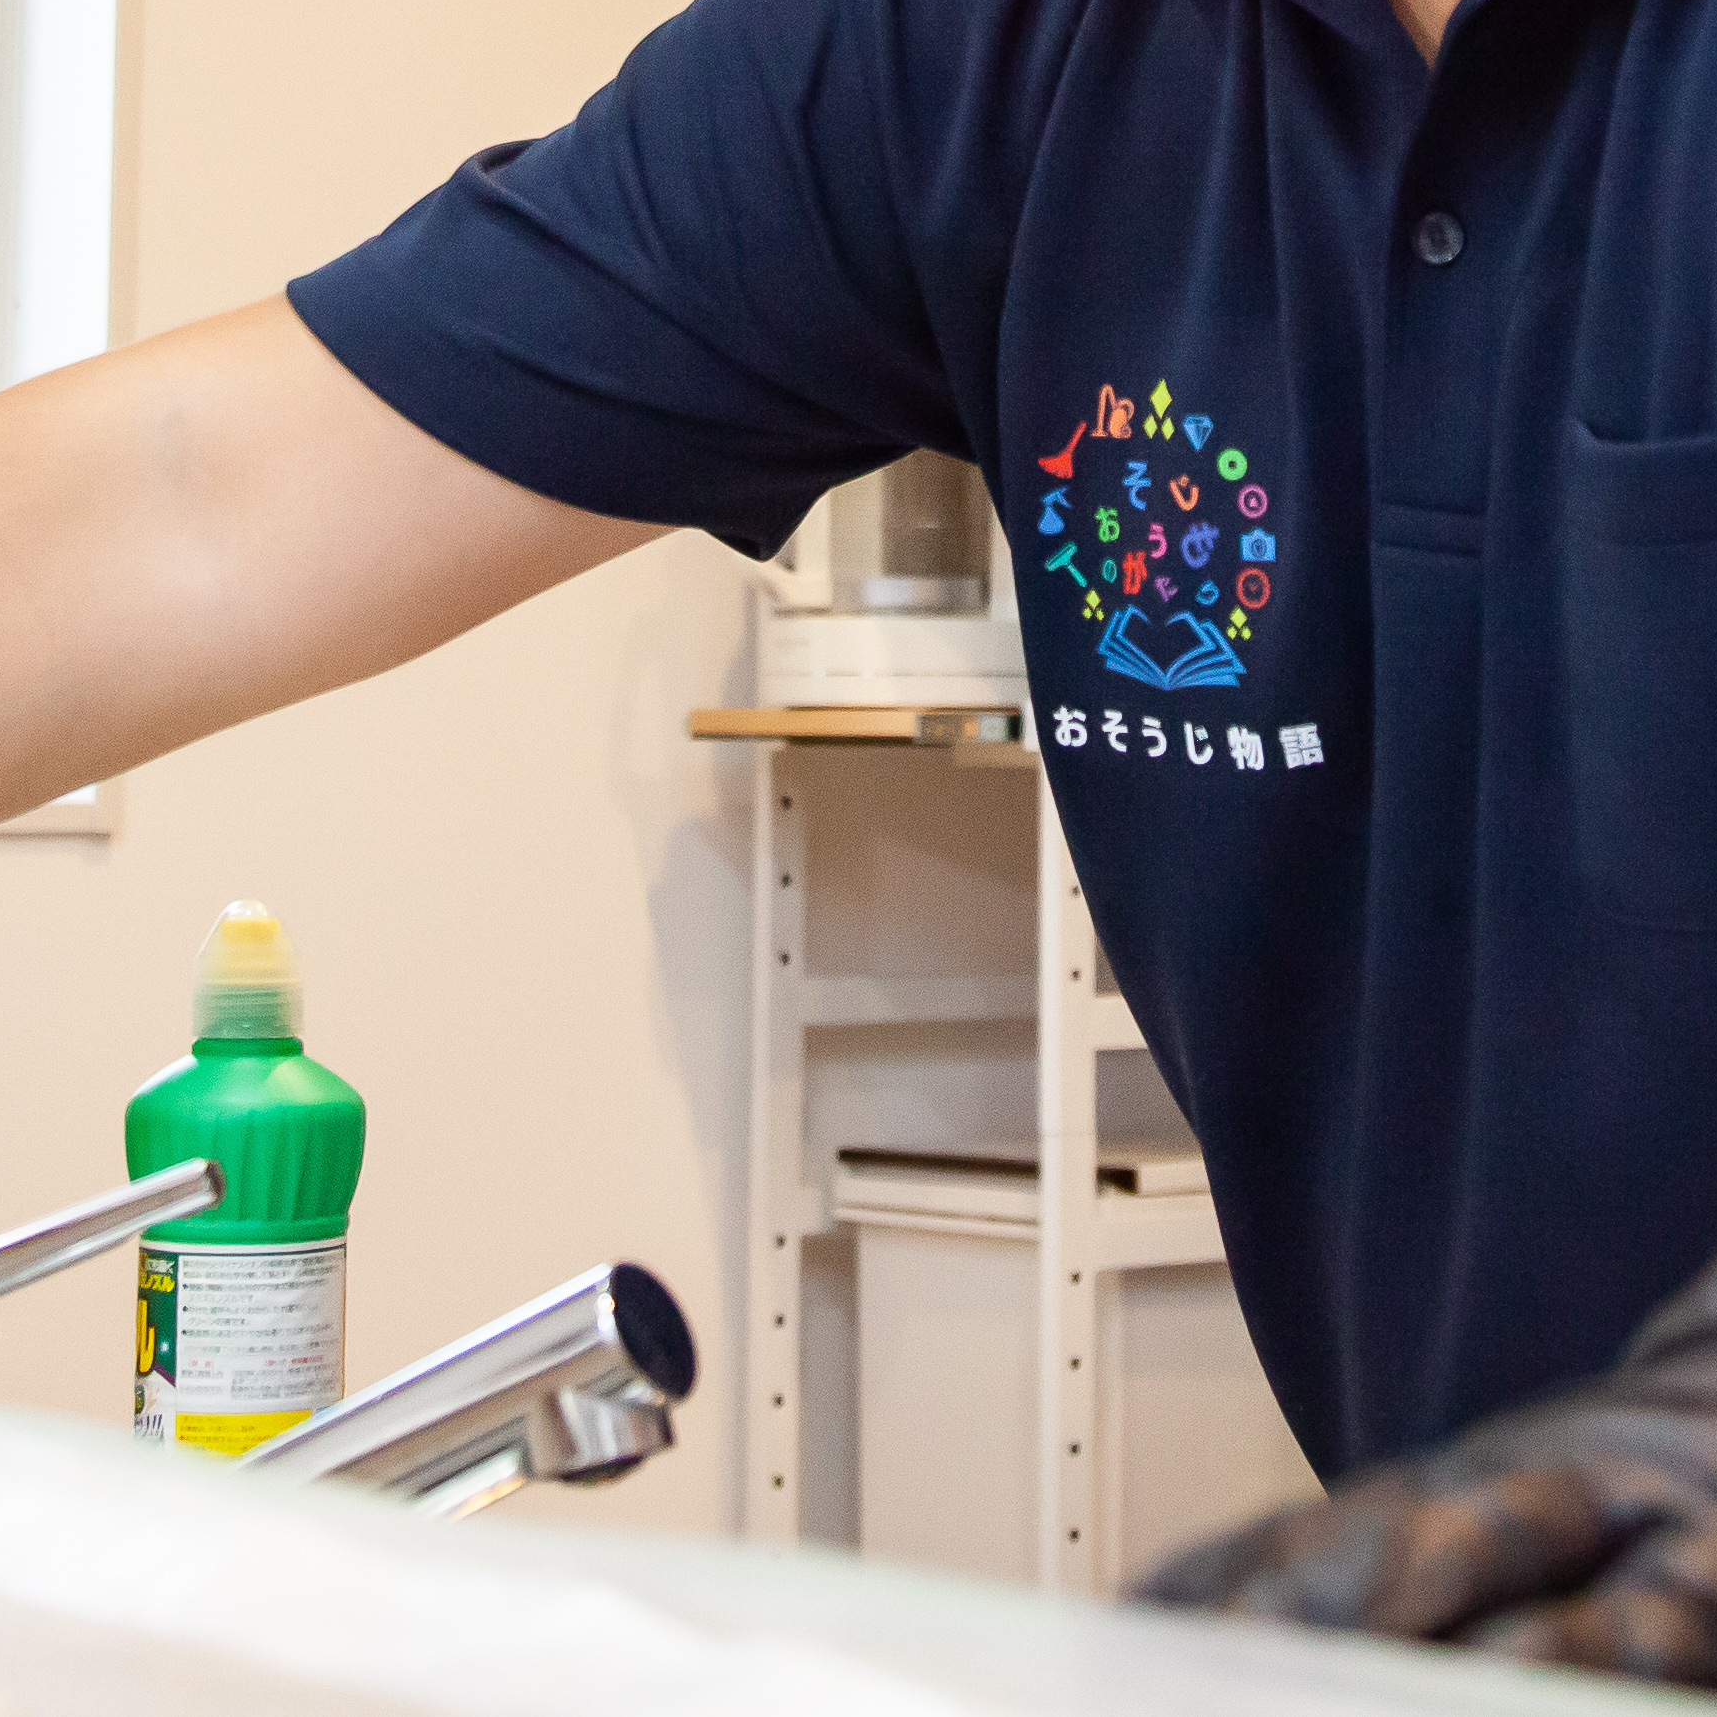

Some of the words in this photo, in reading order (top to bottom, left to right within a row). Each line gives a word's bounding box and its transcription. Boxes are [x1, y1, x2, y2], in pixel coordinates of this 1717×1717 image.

[1052, 704, 1325, 771] おそうじ物語
